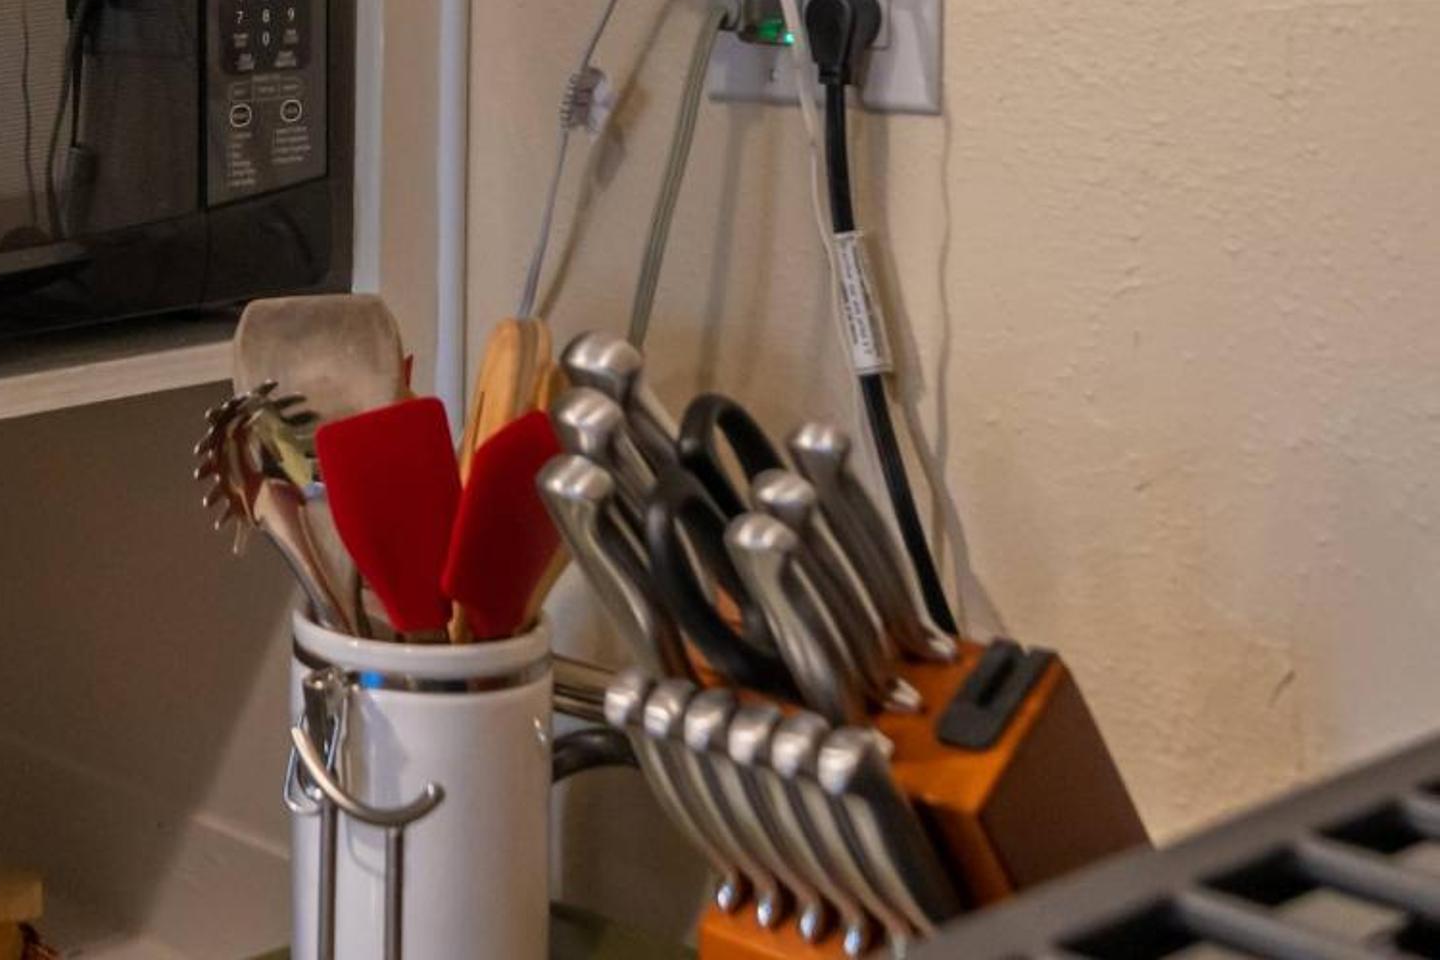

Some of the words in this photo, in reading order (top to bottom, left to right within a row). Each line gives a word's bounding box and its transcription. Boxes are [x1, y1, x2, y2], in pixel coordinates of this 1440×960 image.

[236, 10, 244, 24] 7
[262, 8, 270, 23] 8
[287, 7, 295, 20] 9
[262, 31, 270, 46] 0
